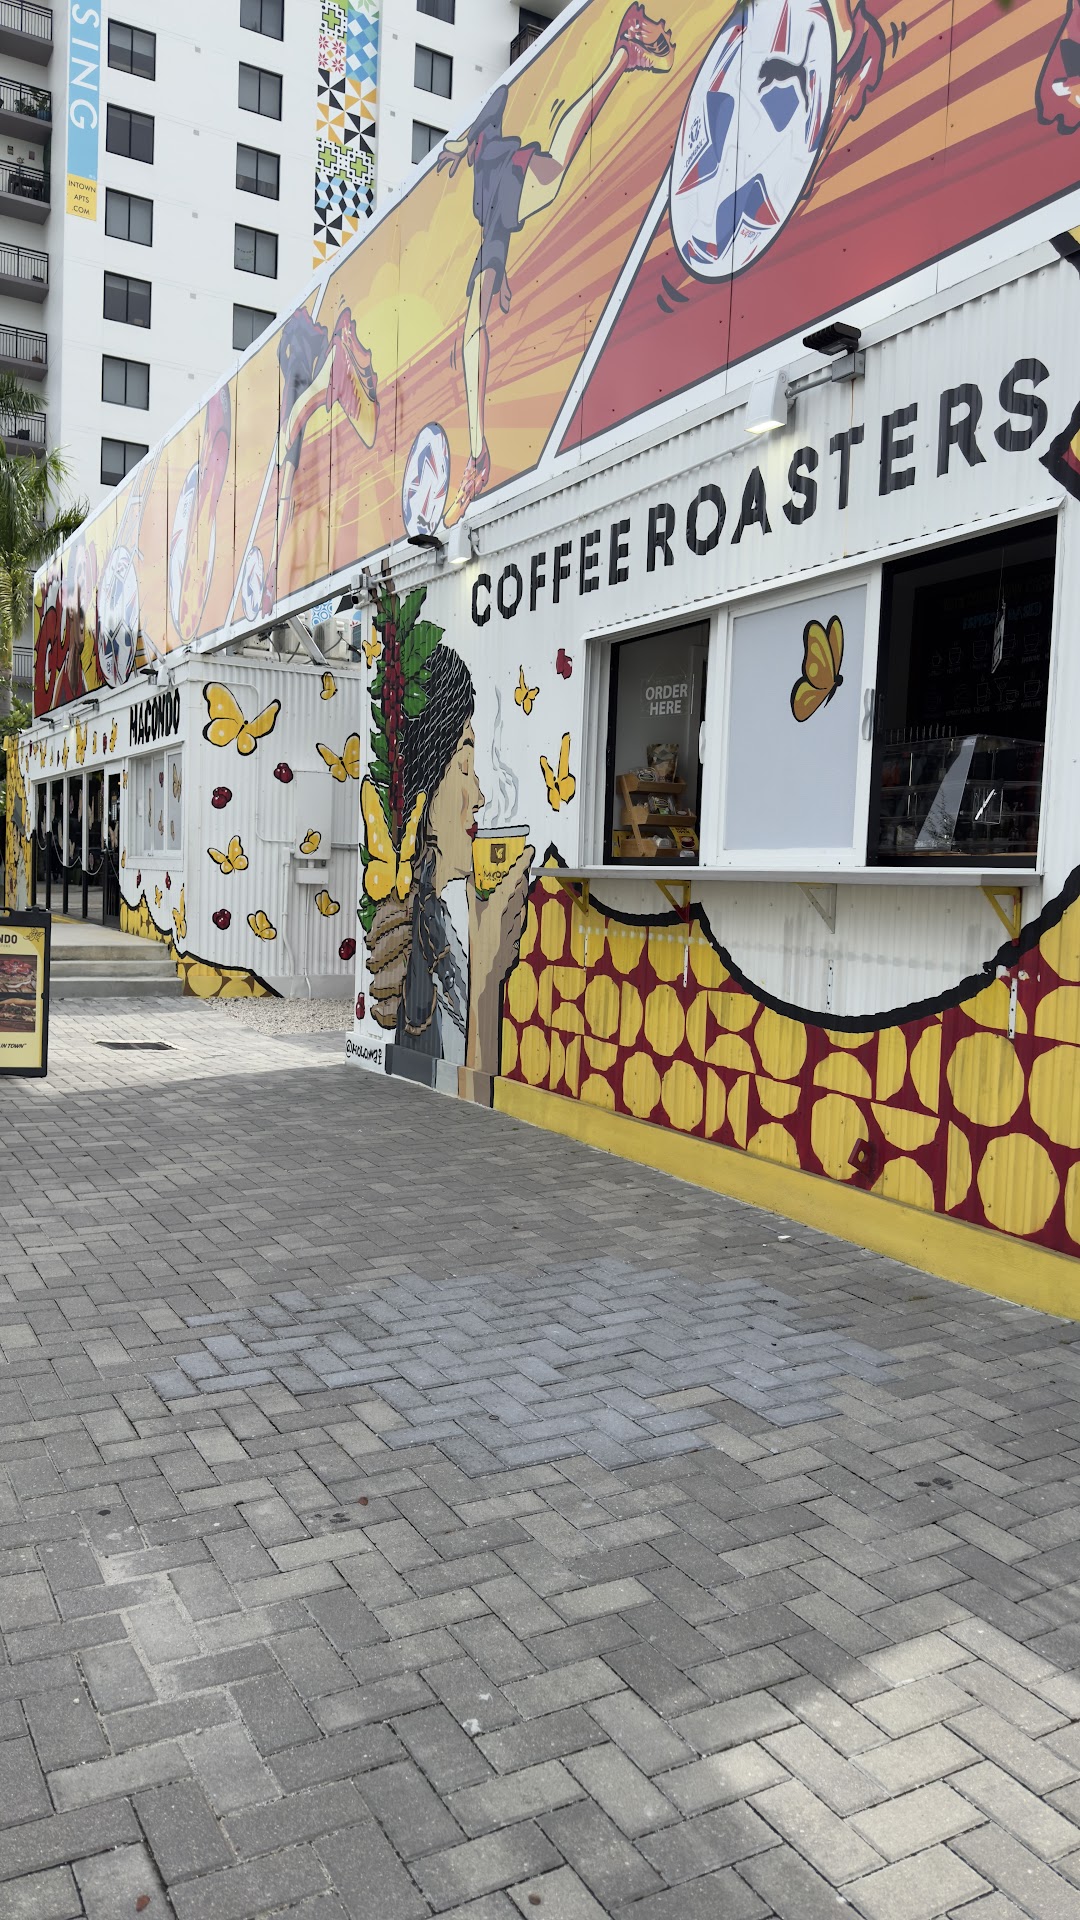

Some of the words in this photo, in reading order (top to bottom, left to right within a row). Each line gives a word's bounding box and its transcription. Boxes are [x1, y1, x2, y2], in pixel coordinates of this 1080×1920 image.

[68, 180, 96, 193] INTOWN
[73, 194, 90, 204] APTS
[470, 517, 630, 627] COFFEE
[646, 357, 1051, 574] ROASTERS
[645, 683, 688, 701] ORDER
[649, 699, 682, 716] HERE
[129, 687, 181, 747] MACONDO
